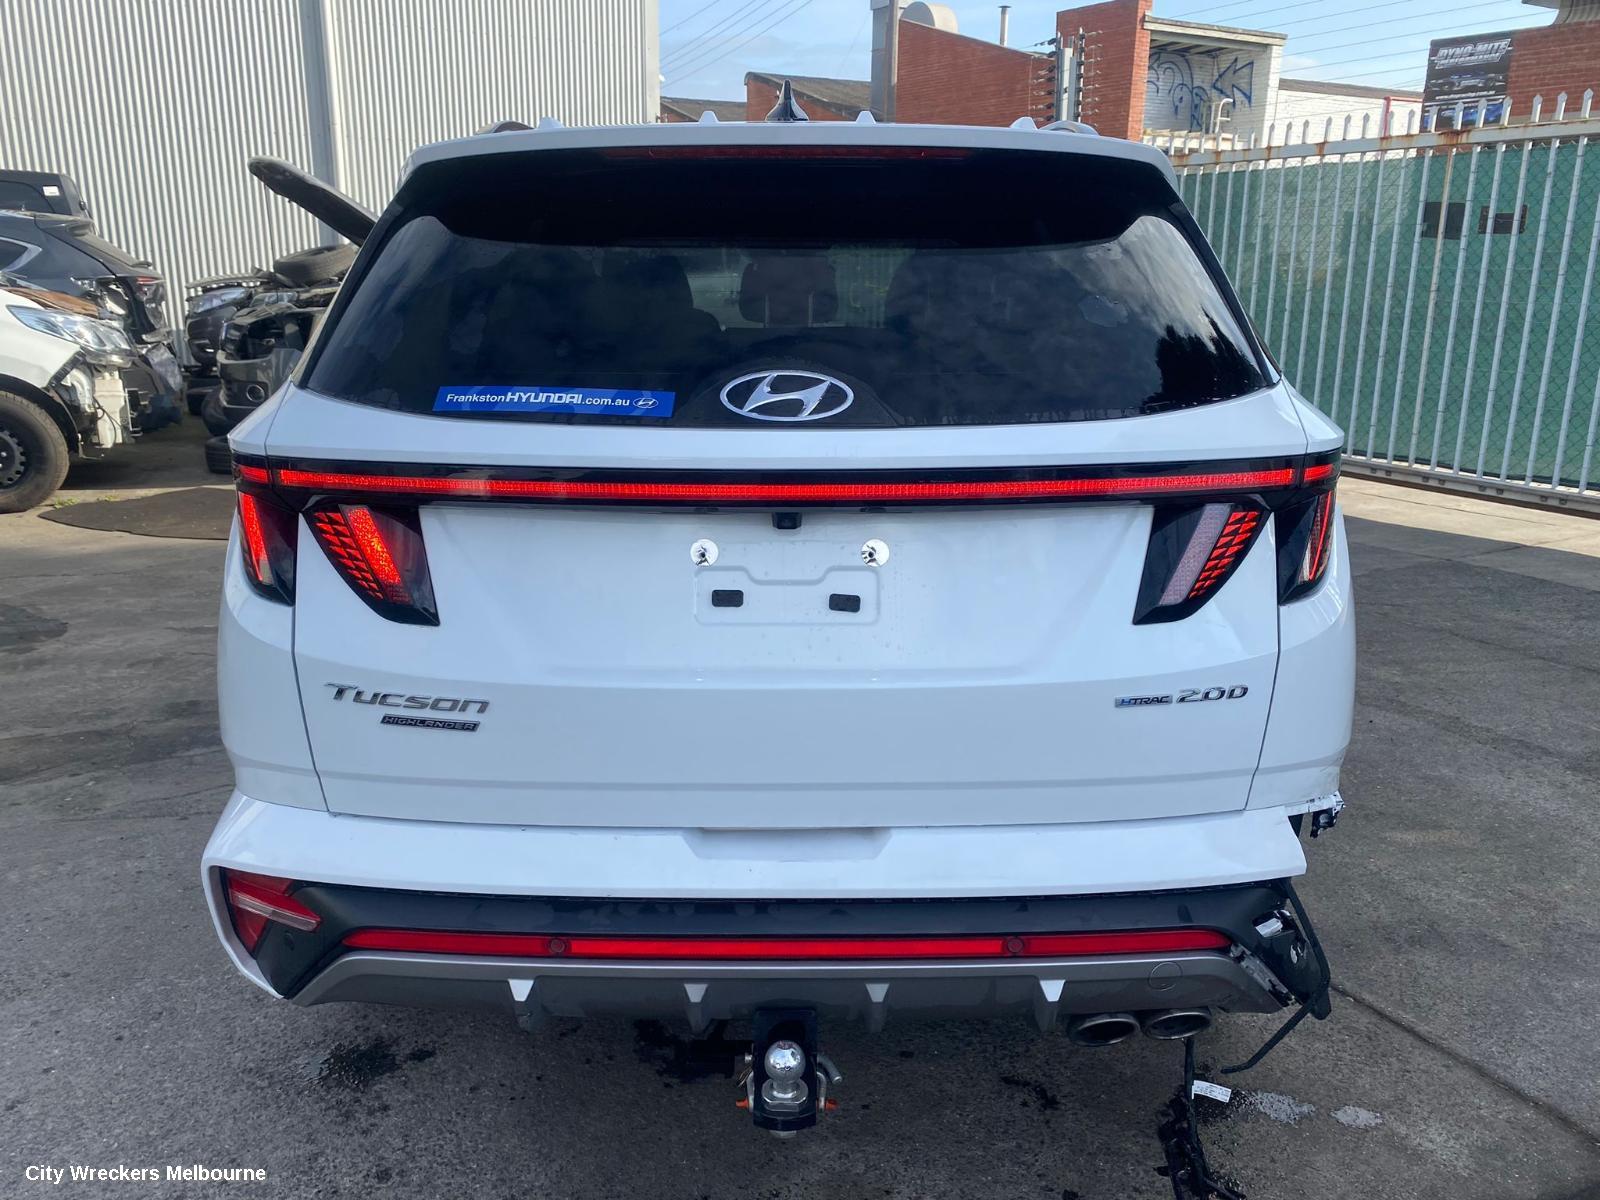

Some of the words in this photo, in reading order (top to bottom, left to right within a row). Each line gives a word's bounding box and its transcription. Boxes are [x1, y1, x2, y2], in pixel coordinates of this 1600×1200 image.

[446, 392, 630, 407] FrankstonHYUNDAI.com.au
[324, 682, 490, 714] TUCSON
[382, 715, 477, 731] HIGHLANDER
